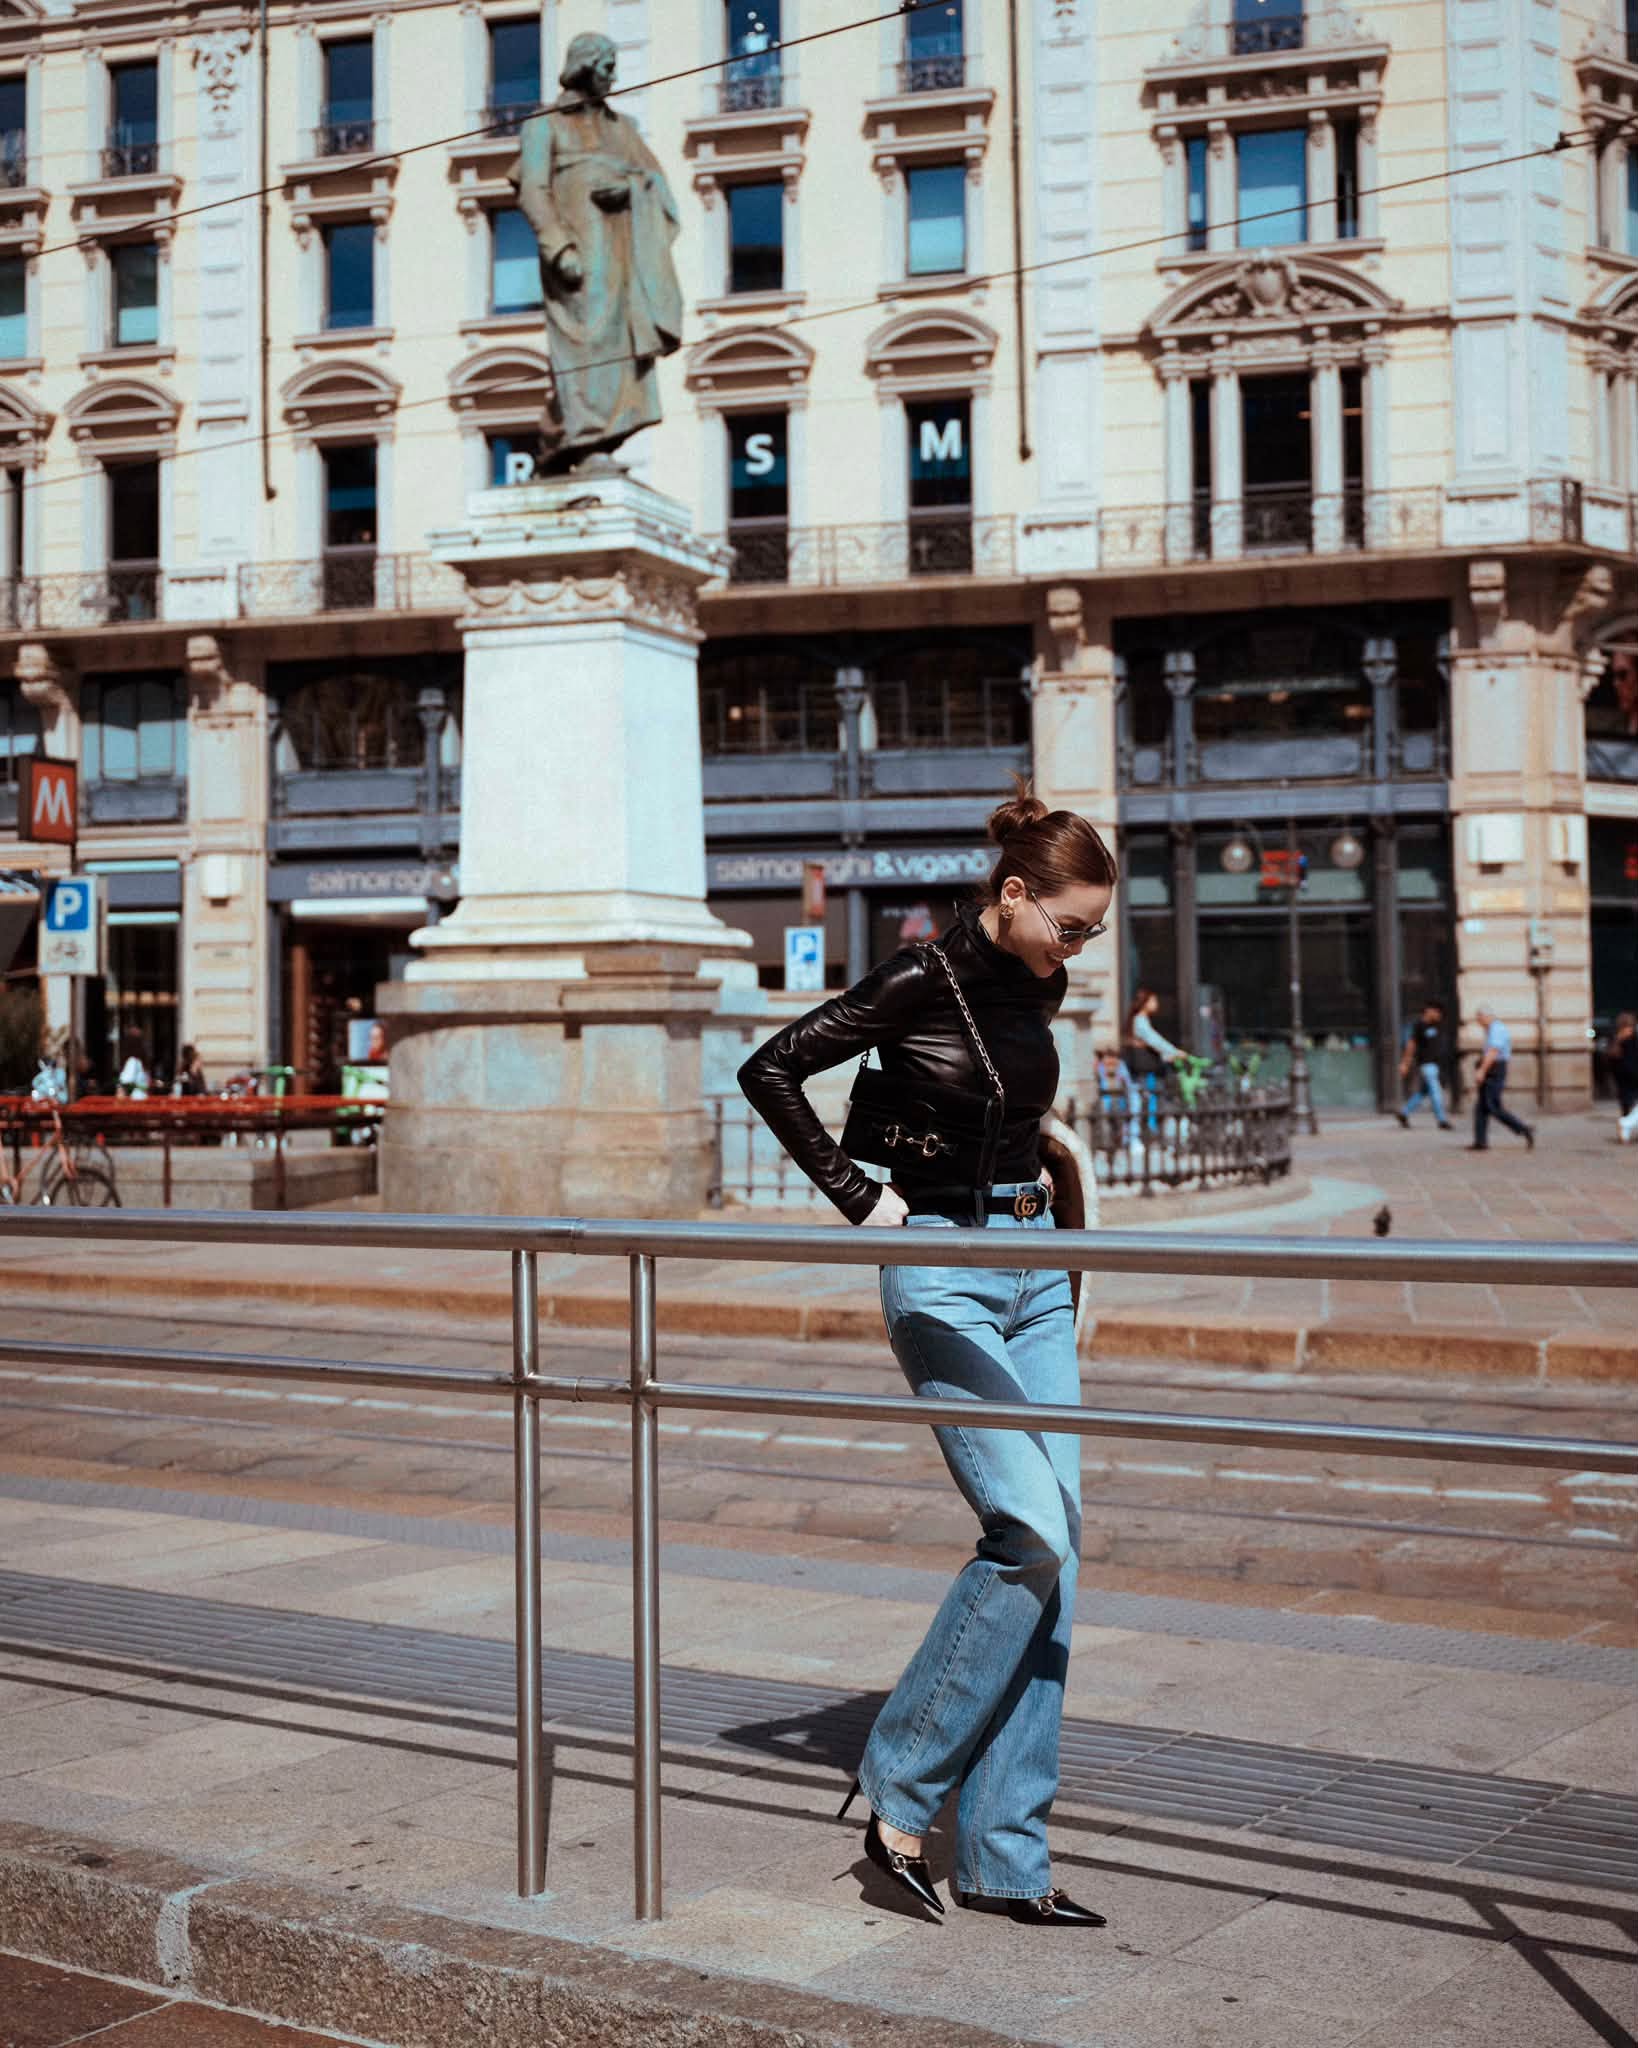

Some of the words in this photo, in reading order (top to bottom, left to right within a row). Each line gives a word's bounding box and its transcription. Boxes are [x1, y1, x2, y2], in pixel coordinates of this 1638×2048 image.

[745, 433, 775, 475] S
[920, 420, 962, 461] M
[34, 776, 72, 827] M
[54, 887, 82, 927] P
